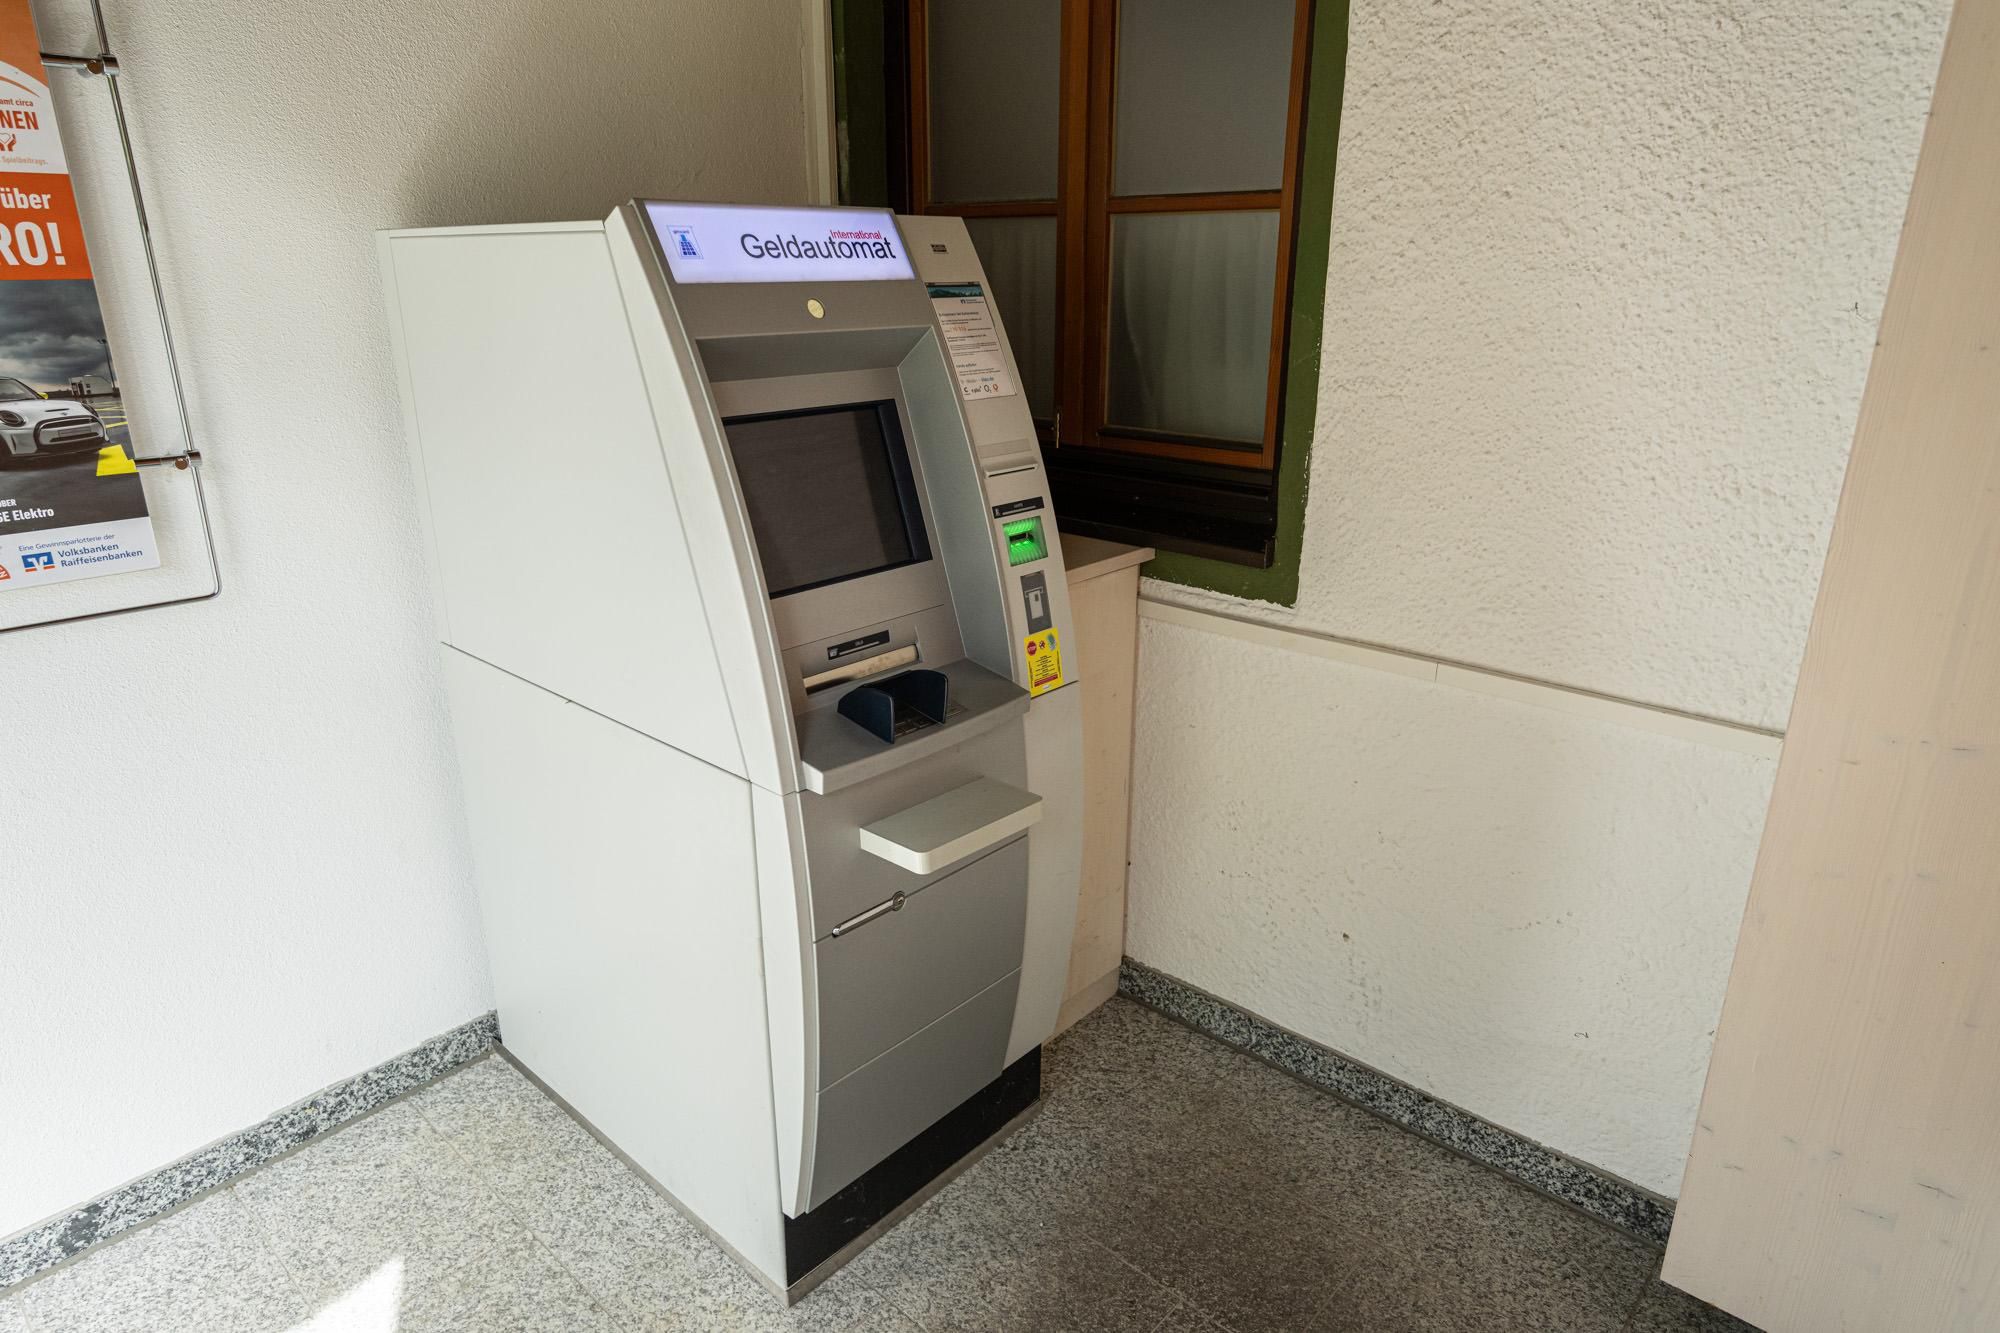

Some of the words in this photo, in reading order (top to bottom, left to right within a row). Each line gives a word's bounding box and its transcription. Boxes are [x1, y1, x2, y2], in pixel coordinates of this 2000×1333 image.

[15, 99, 34, 107] circa
[0, 188, 51, 209] über
[830, 229, 882, 239] International
[740, 233, 896, 259] Geldautomat
[12, 508, 55, 521] Elektro
[35, 535, 102, 550] Gewinnsparlotterie
[103, 533, 115, 541] der
[57, 542, 119, 558] Volksbanken
[61, 549, 143, 568] Raiffeisenbanken
